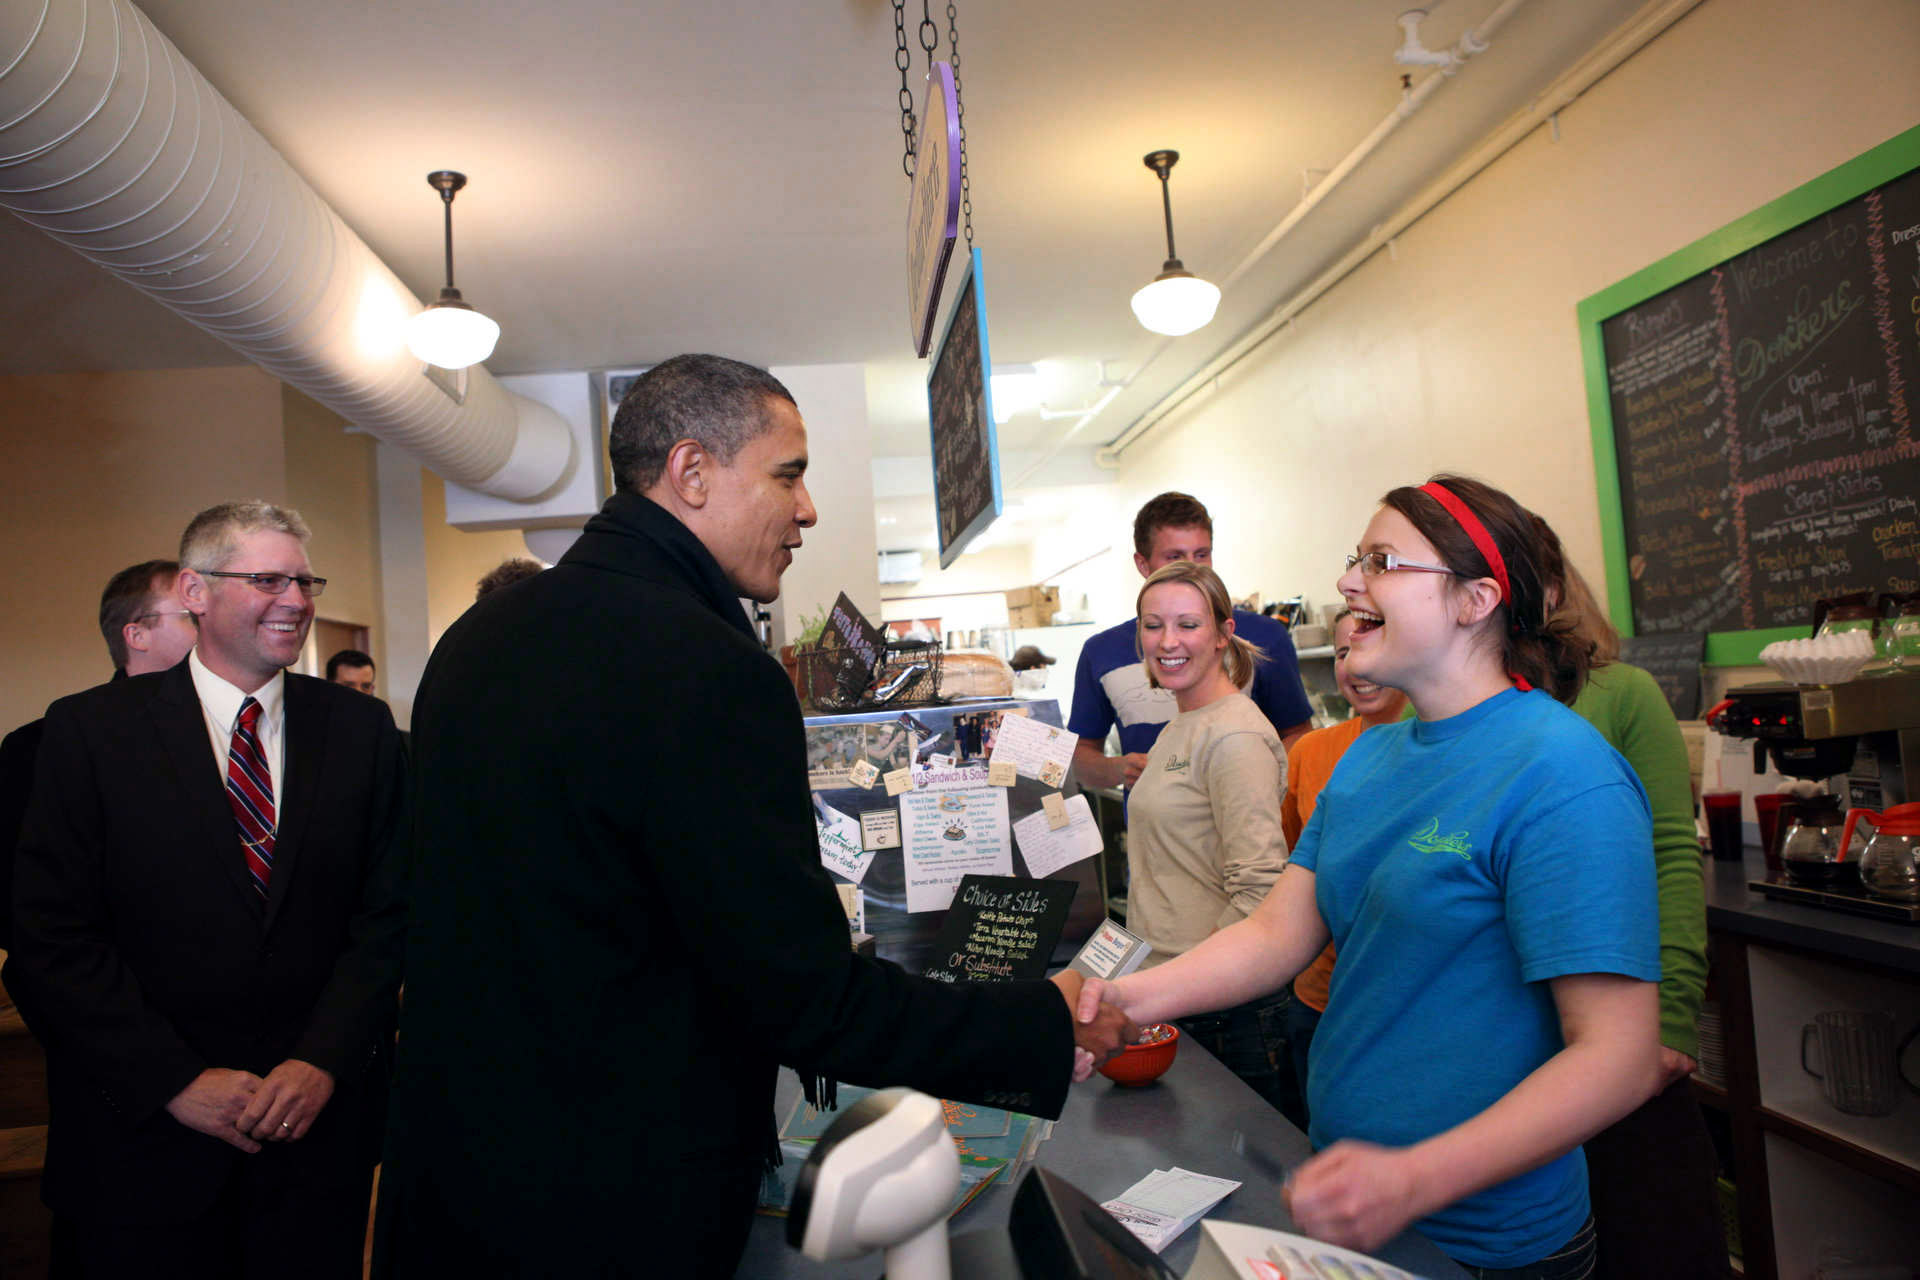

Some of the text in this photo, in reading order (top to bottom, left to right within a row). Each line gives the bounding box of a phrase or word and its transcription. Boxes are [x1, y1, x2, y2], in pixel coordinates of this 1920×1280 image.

[1730, 216, 1859, 304] Welcome to
[1760, 398, 1807, 437] Monday
[1837, 469, 1882, 499] Sides
[911, 773, 924, 787] 1/2
[923, 771, 961, 786] Sandwich
[961, 770, 968, 782] &
[963, 884, 996, 907] Choice
[998, 893, 1013, 909] of
[1012, 888, 1049, 913] Sides
[1015, 915, 1034, 928] Chips
[948, 952, 1014, 977] Or Substitute
